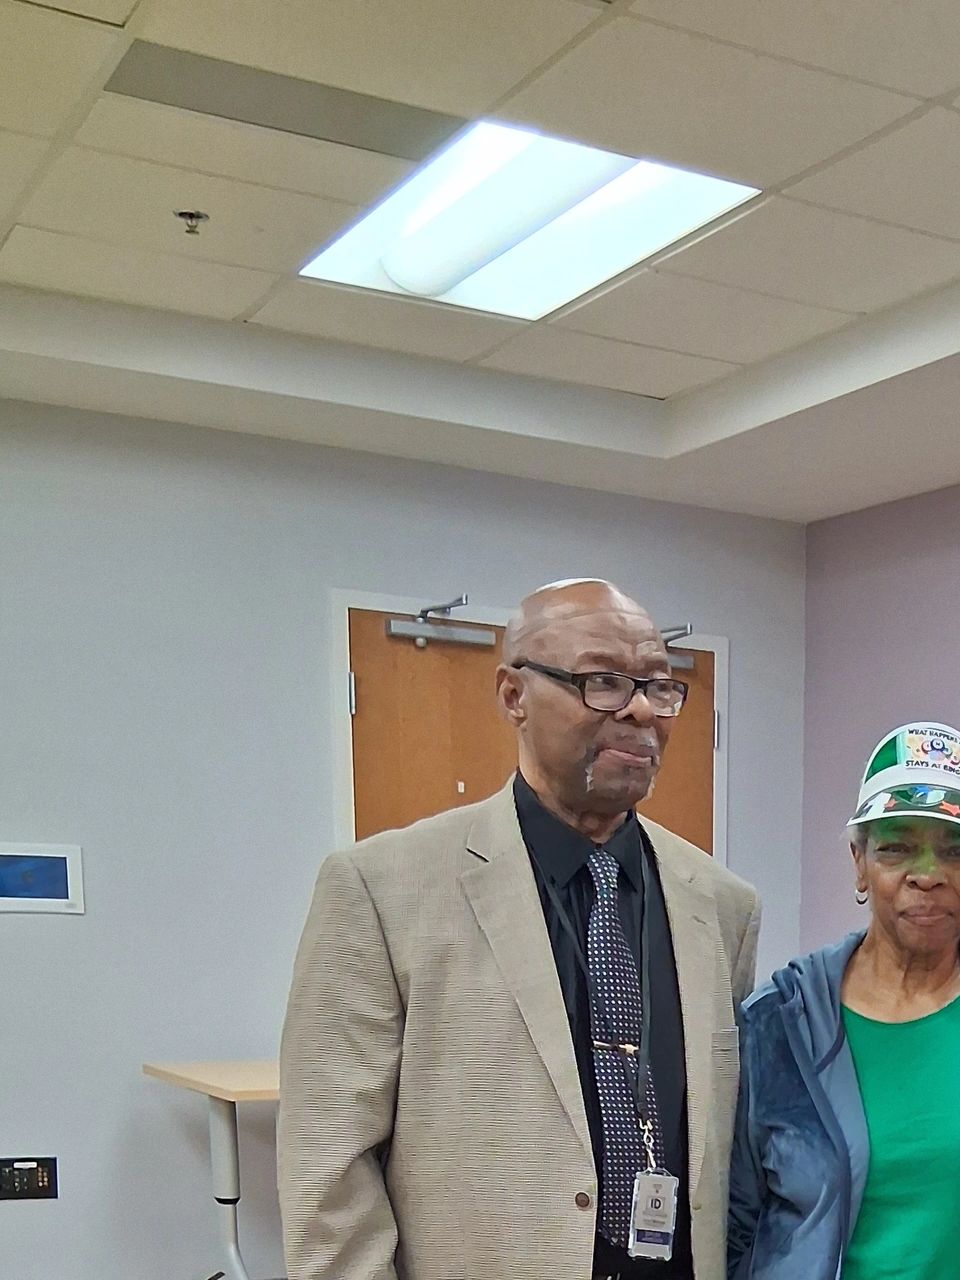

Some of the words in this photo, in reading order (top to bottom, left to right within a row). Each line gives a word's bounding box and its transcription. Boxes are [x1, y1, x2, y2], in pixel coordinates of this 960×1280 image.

[907, 728, 928, 736] WHAT
[905, 760, 929, 768] STAYS
[650, 1198, 662, 1210] ID
